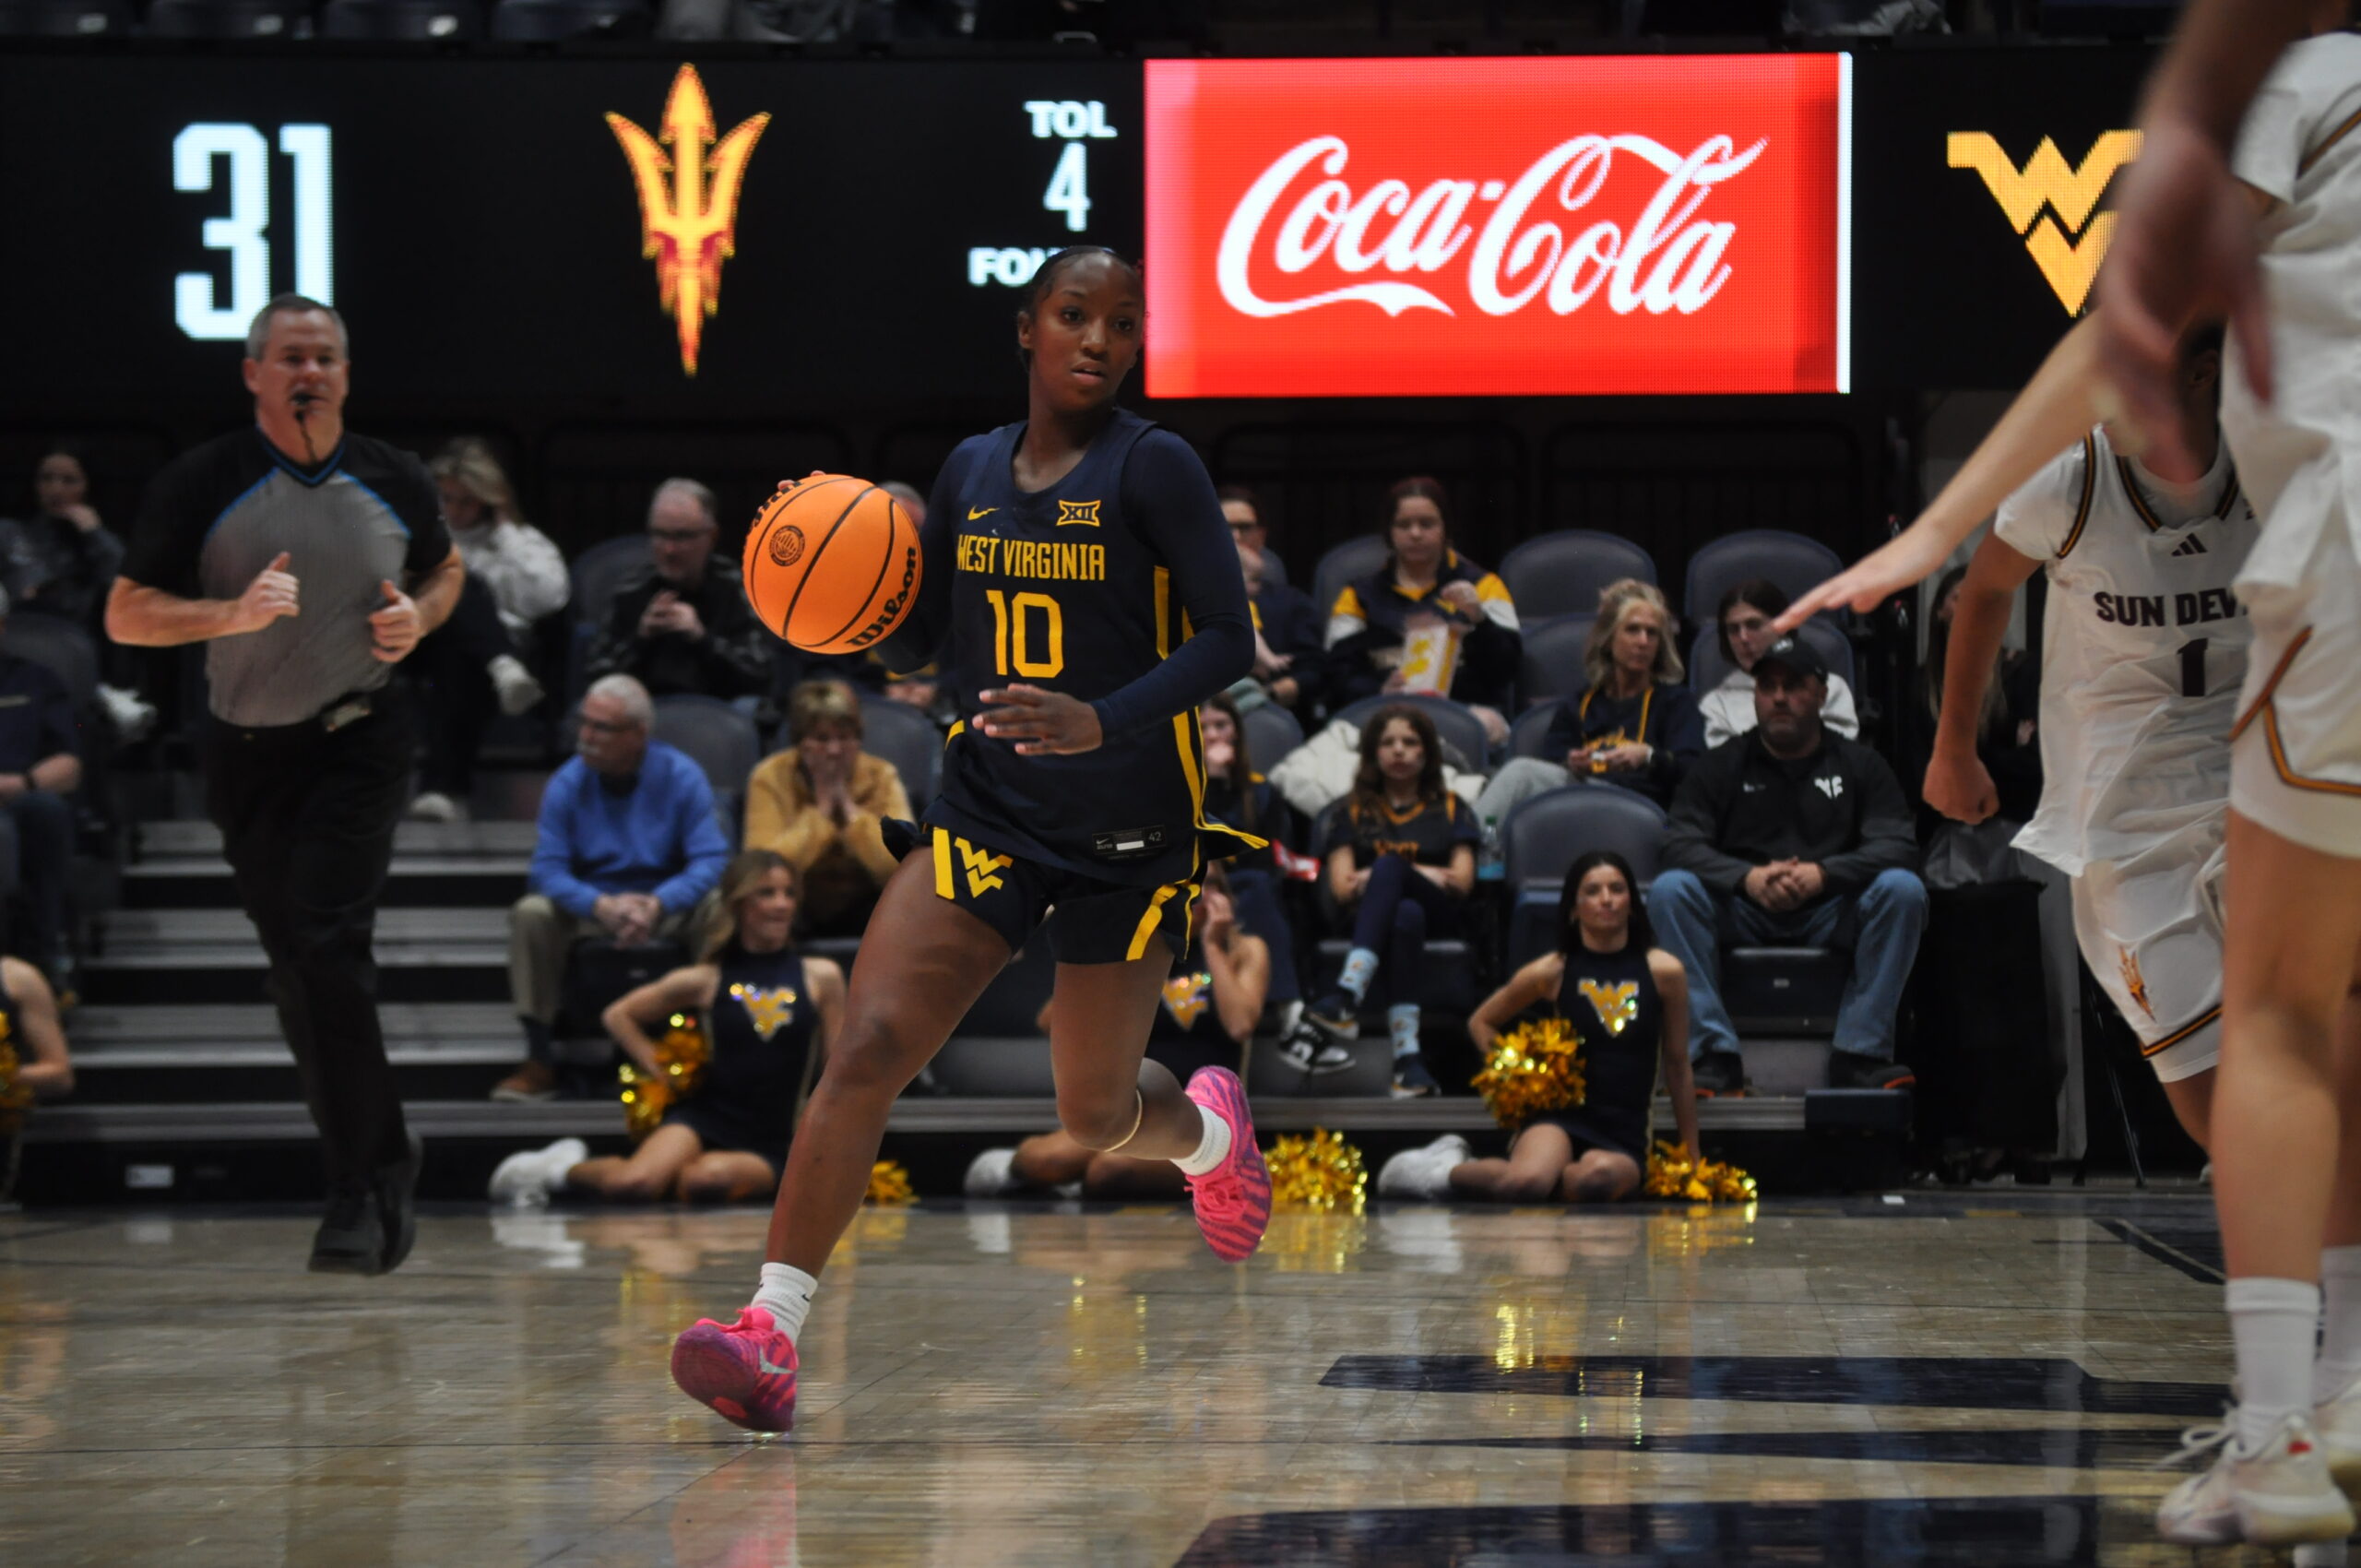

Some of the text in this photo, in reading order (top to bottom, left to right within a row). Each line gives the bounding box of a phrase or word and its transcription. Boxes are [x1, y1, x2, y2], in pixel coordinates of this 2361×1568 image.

[1024, 100, 1118, 138] TOL
[1044, 142, 1091, 232] 4
[172, 123, 335, 339] 31
[1216, 135, 1769, 317] Coca-Cola
[967, 246, 1068, 288] FOU
[956, 534, 1106, 581] WEST VIRGINIA
[846, 546, 916, 647] Wilson
[986, 589, 1063, 678] 10
[2094, 588, 2247, 626] SUN DEV
[2177, 637, 2209, 697] 1
